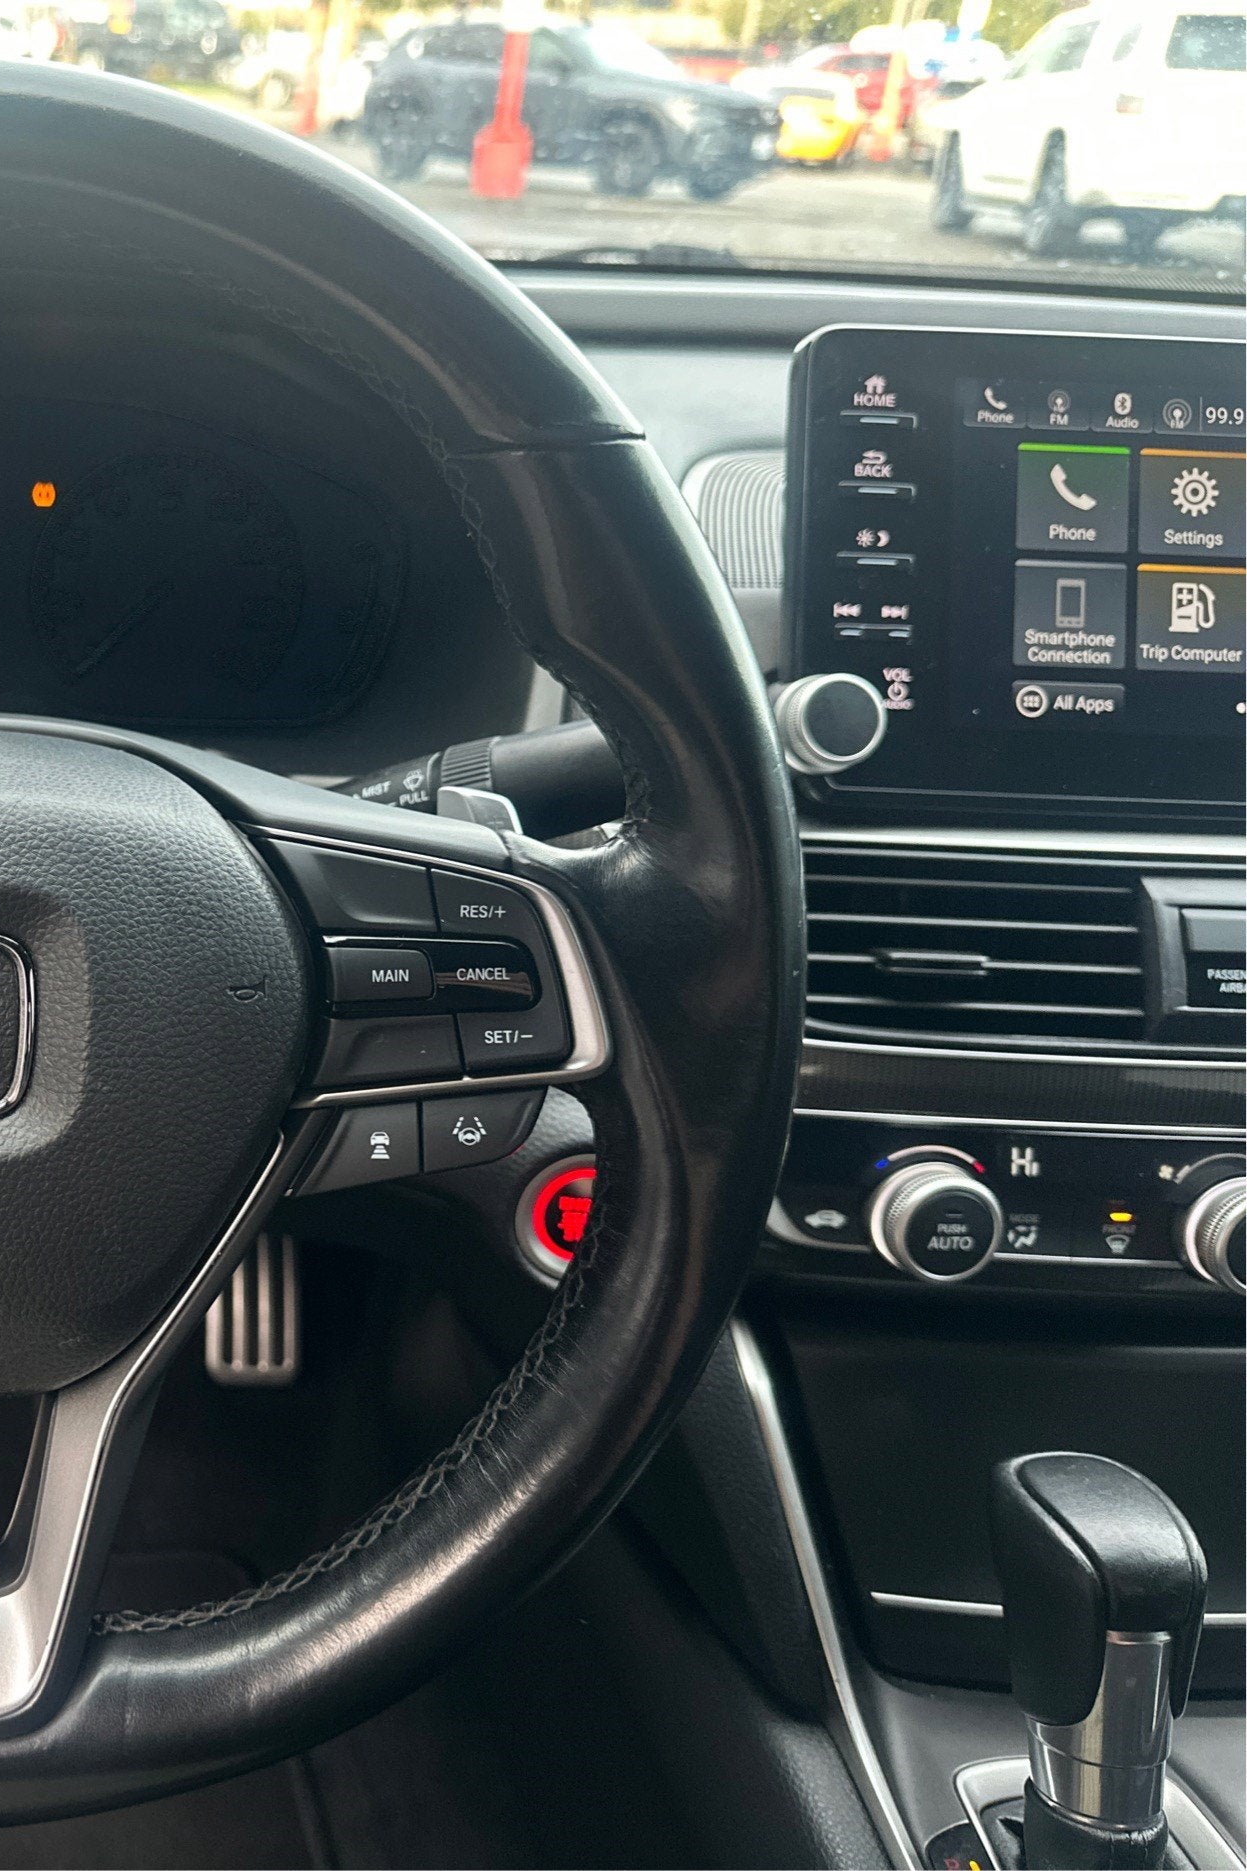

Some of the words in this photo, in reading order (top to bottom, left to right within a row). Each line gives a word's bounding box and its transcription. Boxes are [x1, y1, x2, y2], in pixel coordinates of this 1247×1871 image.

[854, 392, 897, 408] HOME
[977, 410, 1014, 424] Phone
[1049, 413, 1069, 426] FM
[1105, 415, 1139, 429] Audio
[854, 463, 893, 478] BACK
[1049, 524, 1097, 541] Phone
[1164, 528, 1224, 548] Settings
[1024, 628, 1116, 648] Smartphone
[1027, 645, 1111, 664] Connection
[1139, 643, 1169, 662] Trip
[1171, 645, 1243, 664] Computer
[883, 667, 913, 682] VOL
[1053, 694, 1073, 711] All
[1075, 695, 1114, 714] Apps
[459, 904, 506, 919] RES/+
[371, 969, 410, 983] MAIN
[456, 967, 511, 982] CANCEL
[937, 1223, 967, 1234] PUSH
[927, 1236, 975, 1250] AUTO
